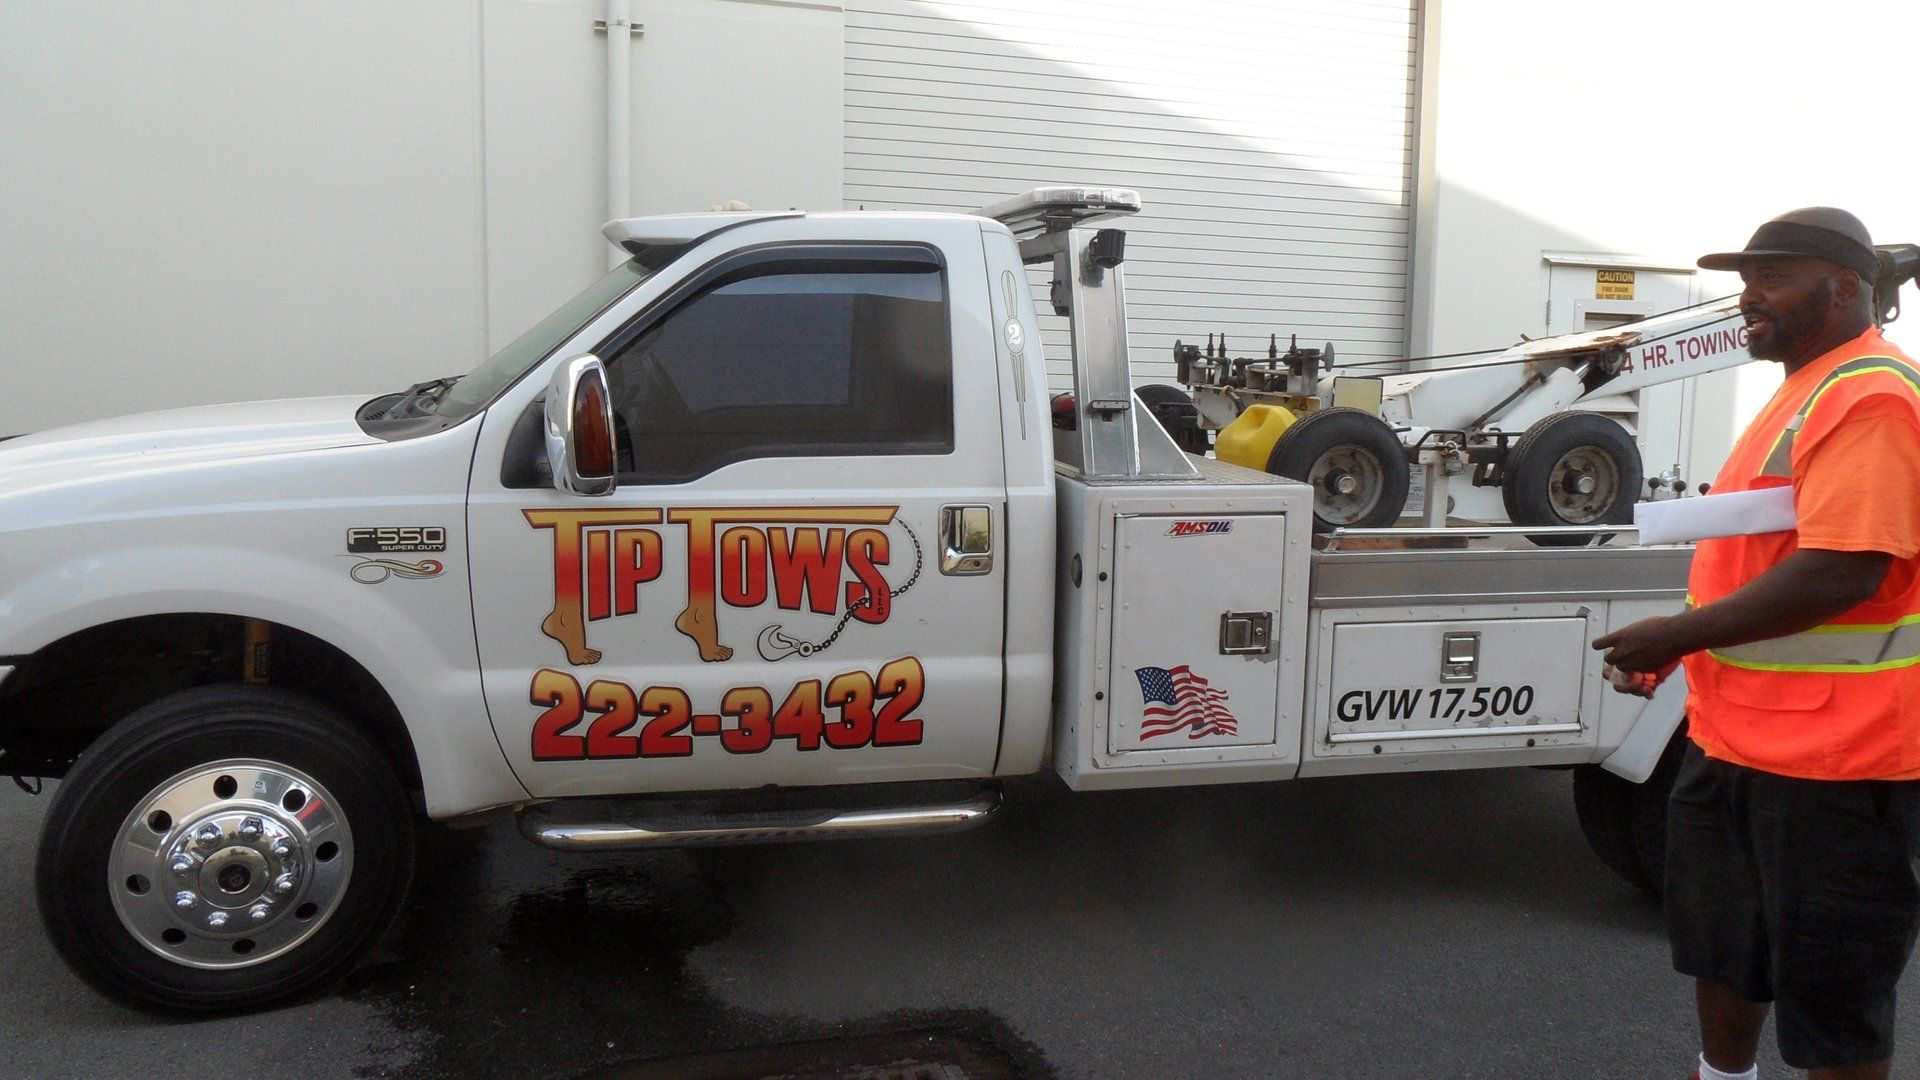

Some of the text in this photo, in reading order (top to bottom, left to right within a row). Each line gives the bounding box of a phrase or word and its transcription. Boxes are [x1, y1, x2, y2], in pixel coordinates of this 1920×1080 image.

[1598, 271, 1634, 282] CAUTION
[1007, 324, 1021, 345] 2
[1642, 344, 1674, 370] HR.
[1676, 325, 1750, 362] TOWING
[1168, 521, 1231, 536] AMSOIL
[530, 656, 924, 761] 222-3432
[1337, 685, 1534, 722] GVW 17,500
